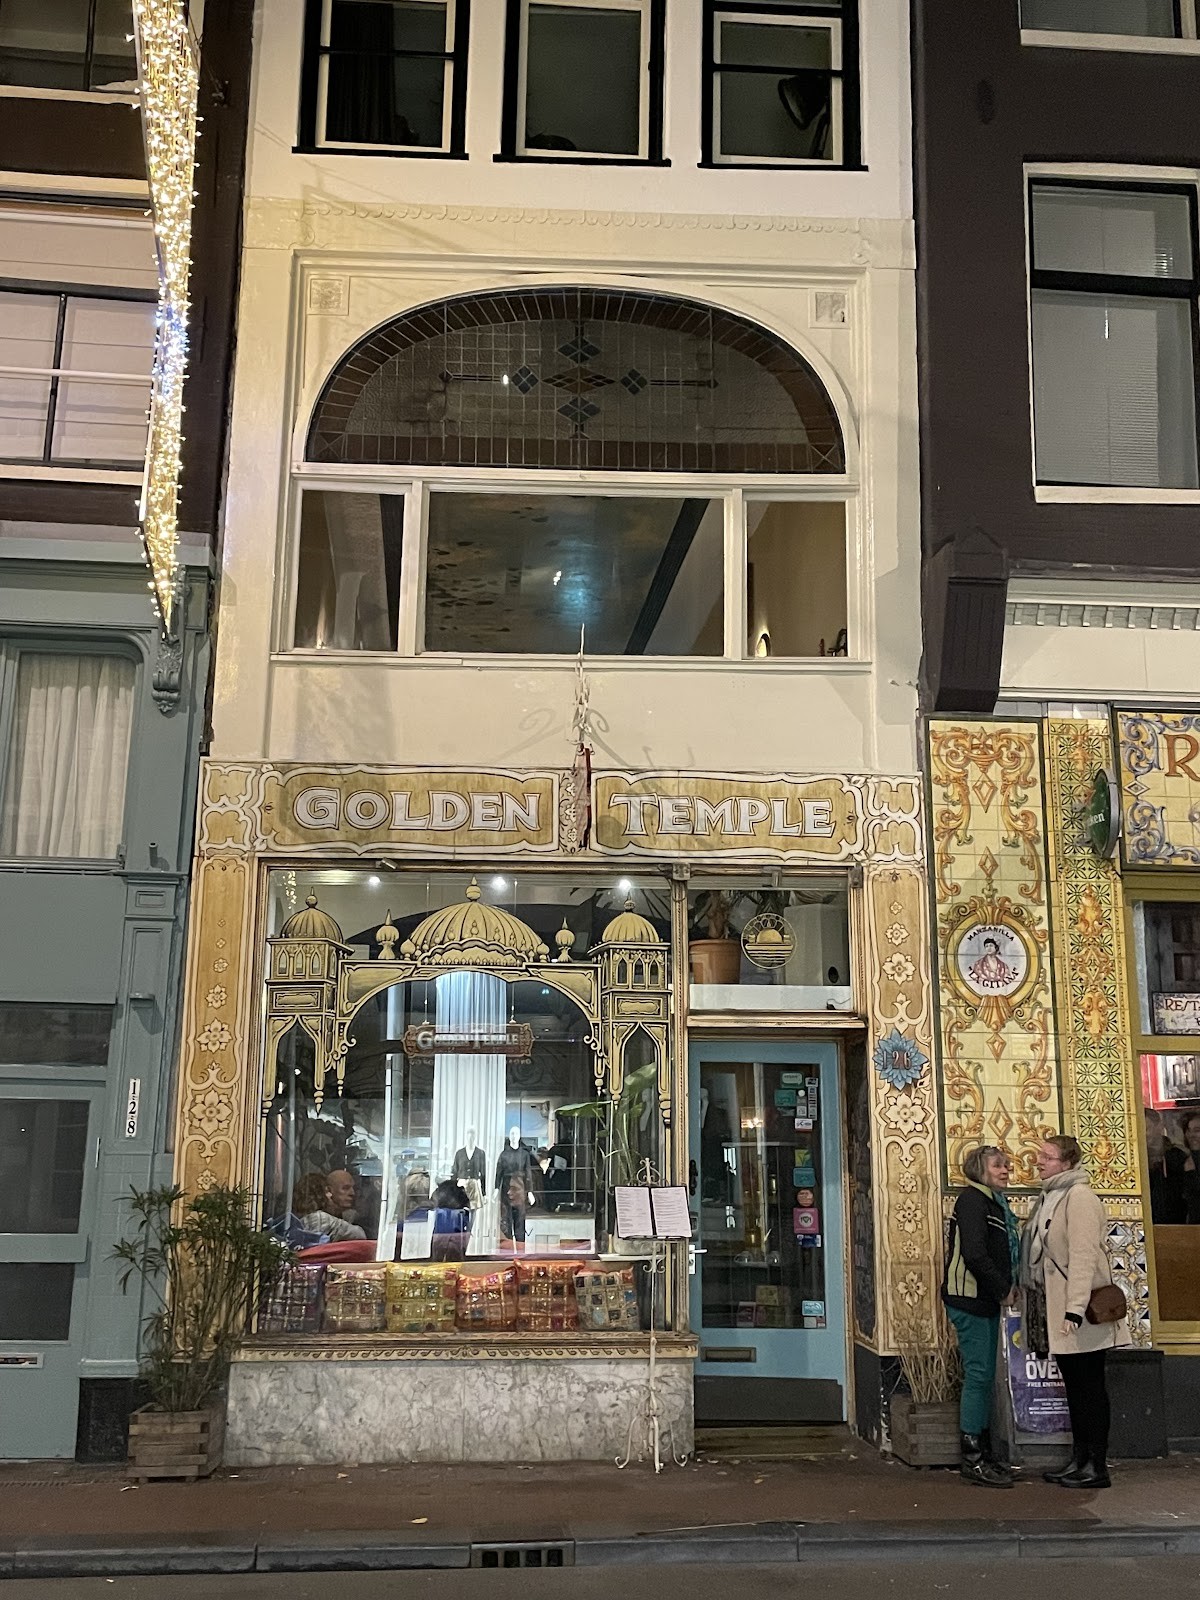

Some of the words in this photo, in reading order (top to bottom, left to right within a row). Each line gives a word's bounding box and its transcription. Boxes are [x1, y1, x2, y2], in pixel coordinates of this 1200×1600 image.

[1164, 733, 1200, 782] R
[293, 785, 543, 833] GOLDEN
[608, 792, 837, 838] TEMPLE
[967, 926, 1015, 942] MANZANILLA
[882, 1050, 911, 1070] 126
[127, 1081, 137, 1134] 128
